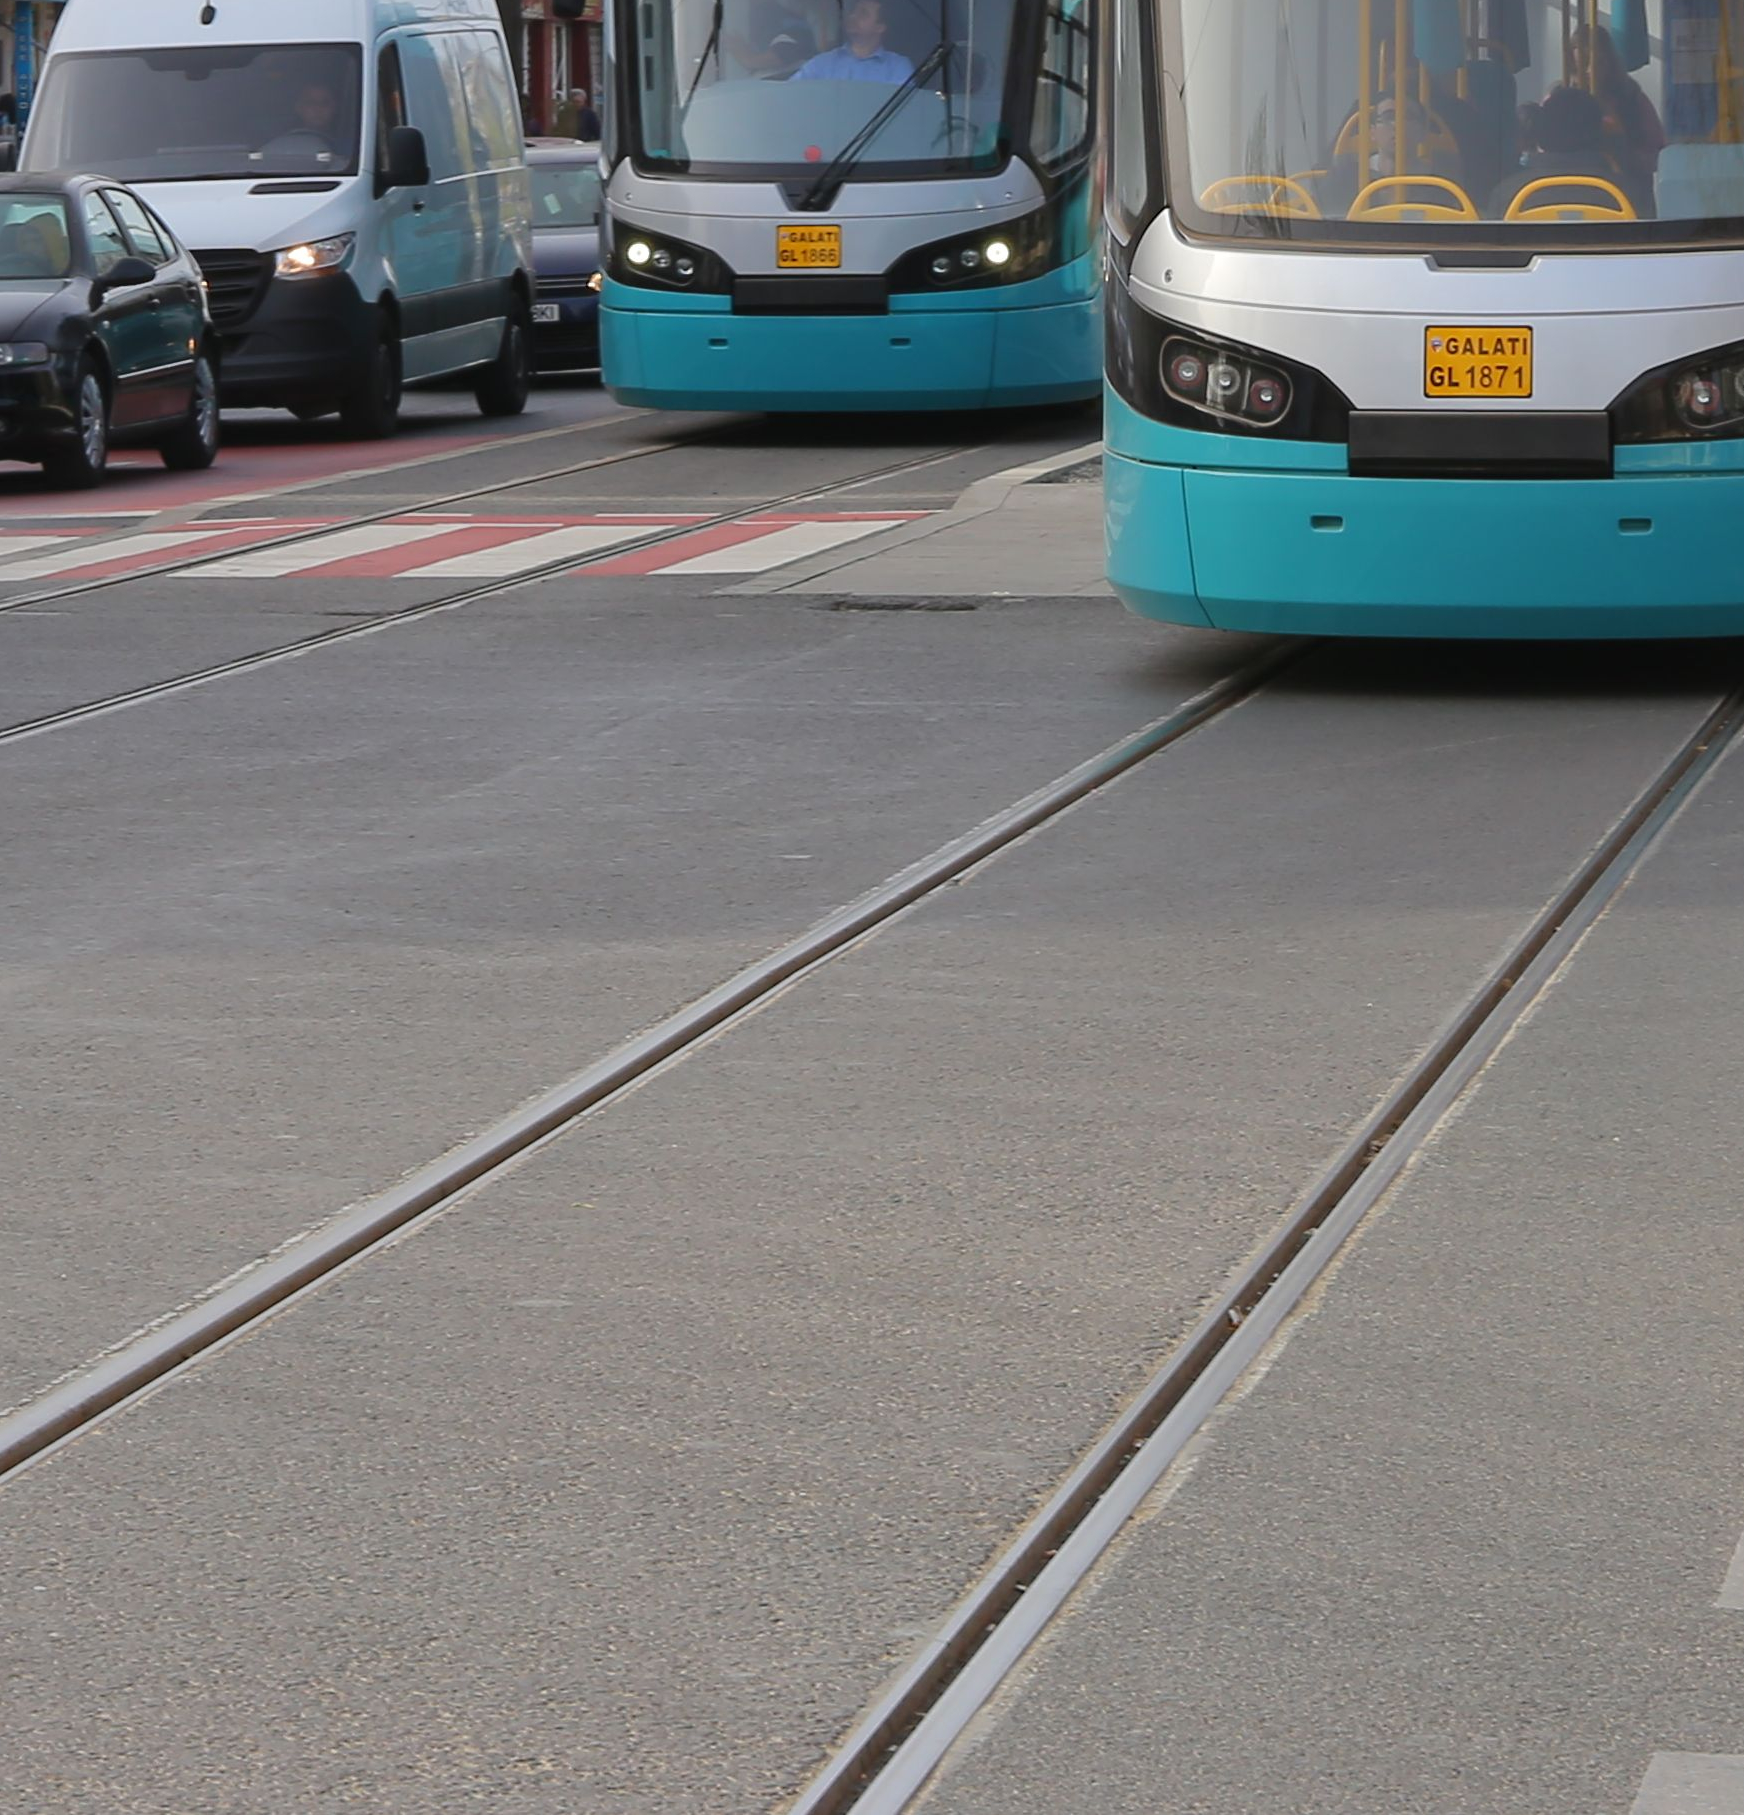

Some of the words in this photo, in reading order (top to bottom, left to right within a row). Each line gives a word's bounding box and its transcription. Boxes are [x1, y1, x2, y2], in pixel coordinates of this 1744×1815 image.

[790, 231, 840, 243] GALATI
[781, 249, 798, 263] GL
[1445, 337, 1528, 355] GALATI
[1430, 366, 1460, 388] GL
[1465, 366, 1523, 389] 1871
